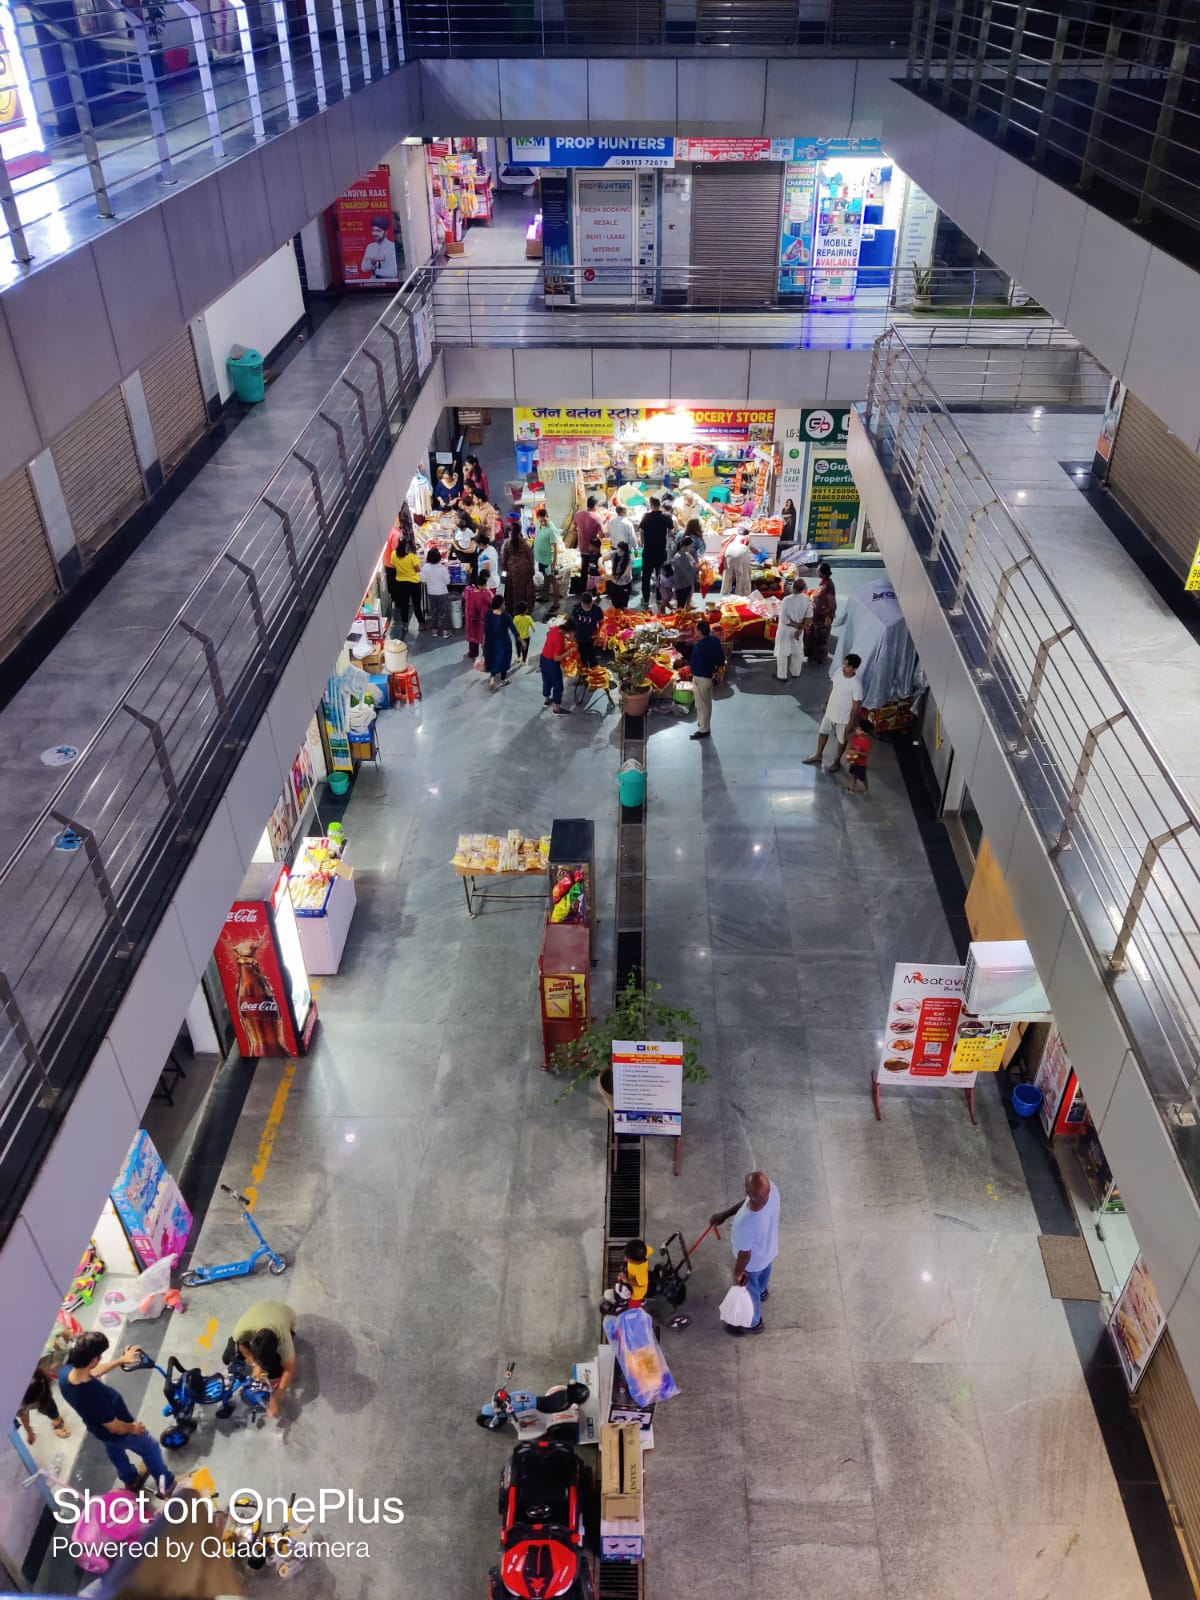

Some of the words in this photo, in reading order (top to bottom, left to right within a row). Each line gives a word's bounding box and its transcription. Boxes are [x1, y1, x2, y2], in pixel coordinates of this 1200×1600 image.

[556, 137, 595, 149] PROP
[598, 137, 666, 150] HUNTERS
[342, 189, 367, 198] ANDIYA
[368, 188, 387, 197] RAAS
[370, 201, 388, 209] KHAN
[823, 239, 853, 247] MOBILE
[816, 248, 858, 257] REPAIRING
[815, 258, 857, 266] AVAILABLE
[687, 411, 734, 423] ROCERY
[736, 412, 774, 423] STORE
